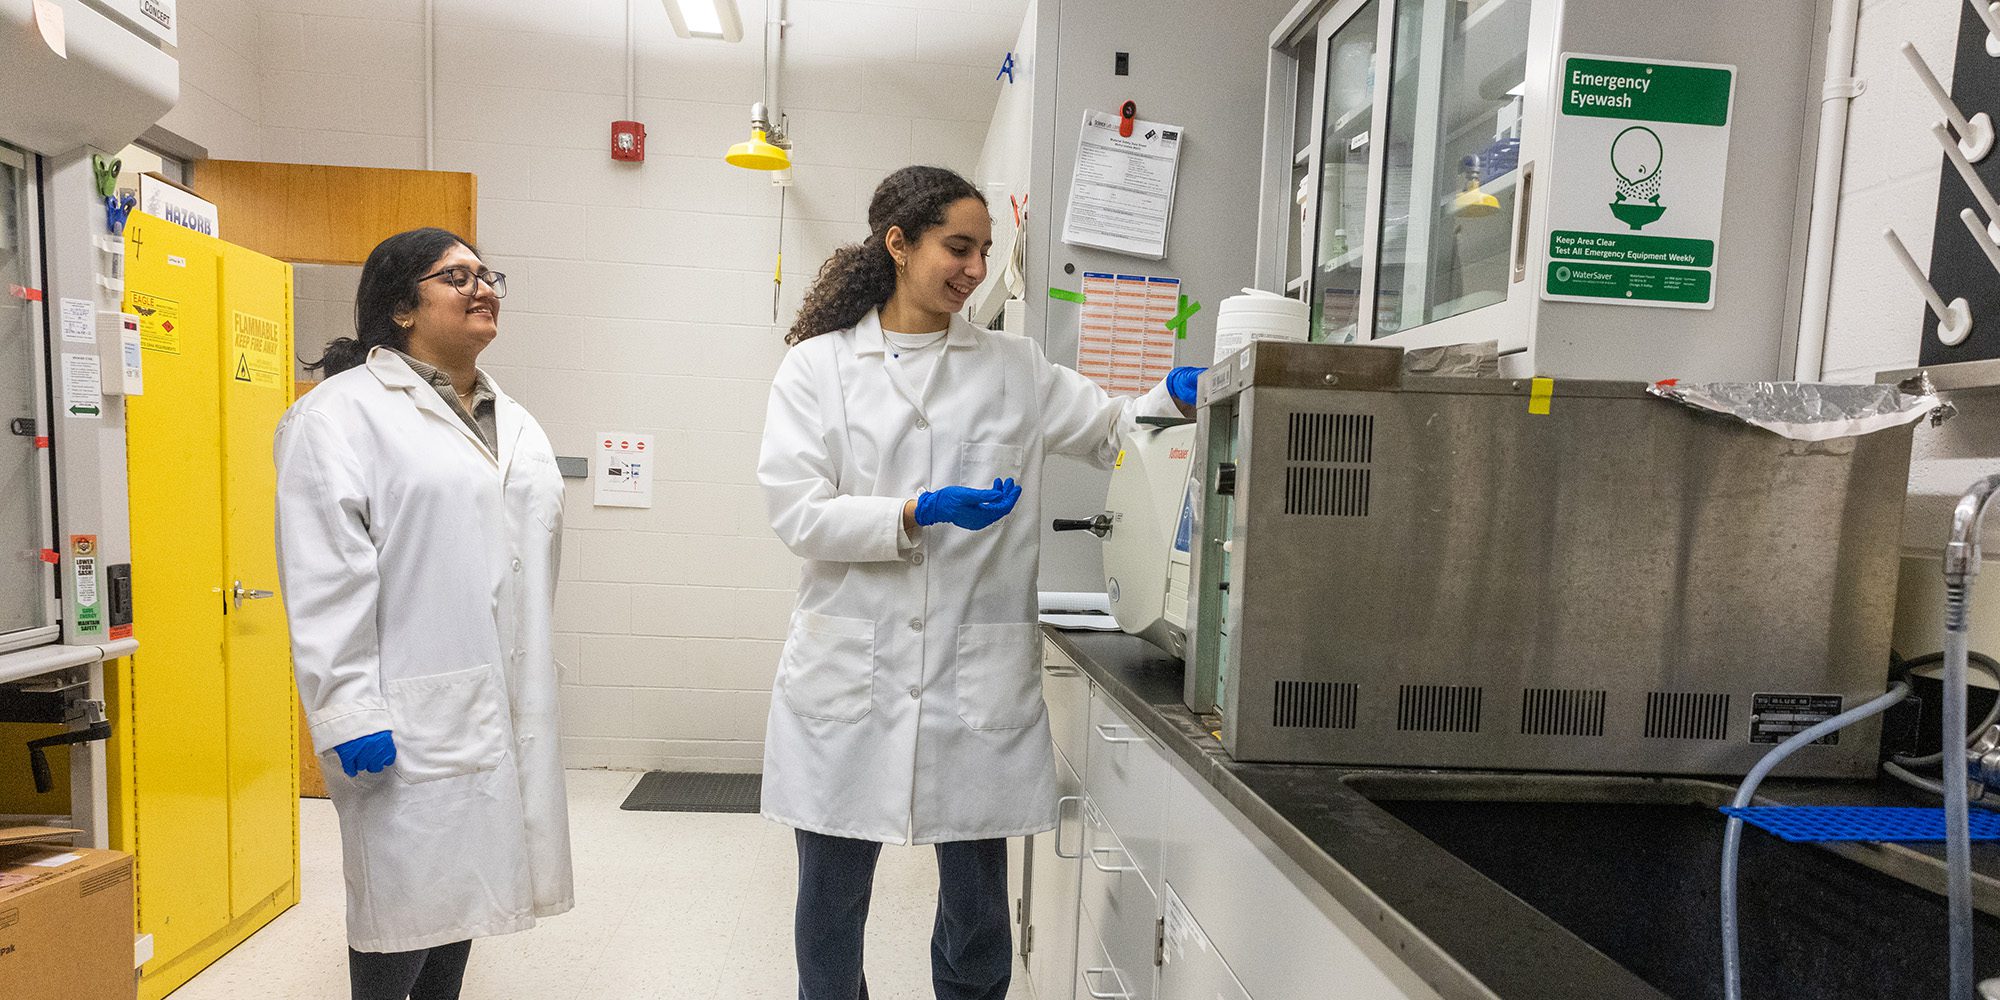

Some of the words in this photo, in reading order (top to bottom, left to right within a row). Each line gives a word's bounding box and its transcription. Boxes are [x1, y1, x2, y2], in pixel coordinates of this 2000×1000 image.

[145, 0, 170, 25] CONCEPT
[1573, 70, 1650, 93] Emergency
[1570, 90, 1632, 108] Eyewash
[165, 202, 212, 236] HAZORB
[132, 226, 143, 260] 4
[1555, 235, 1575, 246] Keep
[1577, 237, 1594, 246] Area
[1596, 238, 1616, 247] Clear
[1555, 246, 1571, 255] Test
[1572, 247, 1583, 255] All
[1584, 248, 1626, 260] Emergency
[1627, 250, 1667, 261] Equipment
[1668, 253, 1696, 264] Weekly
[1572, 270, 1613, 281] WaterSaver
[133, 293, 155, 307] EAGLE
[235, 312, 278, 343] FLAMMABLE
[235, 332, 250, 348] KEEP
[250, 336, 263, 352] FIRE
[263, 340, 278, 356] AWAY
